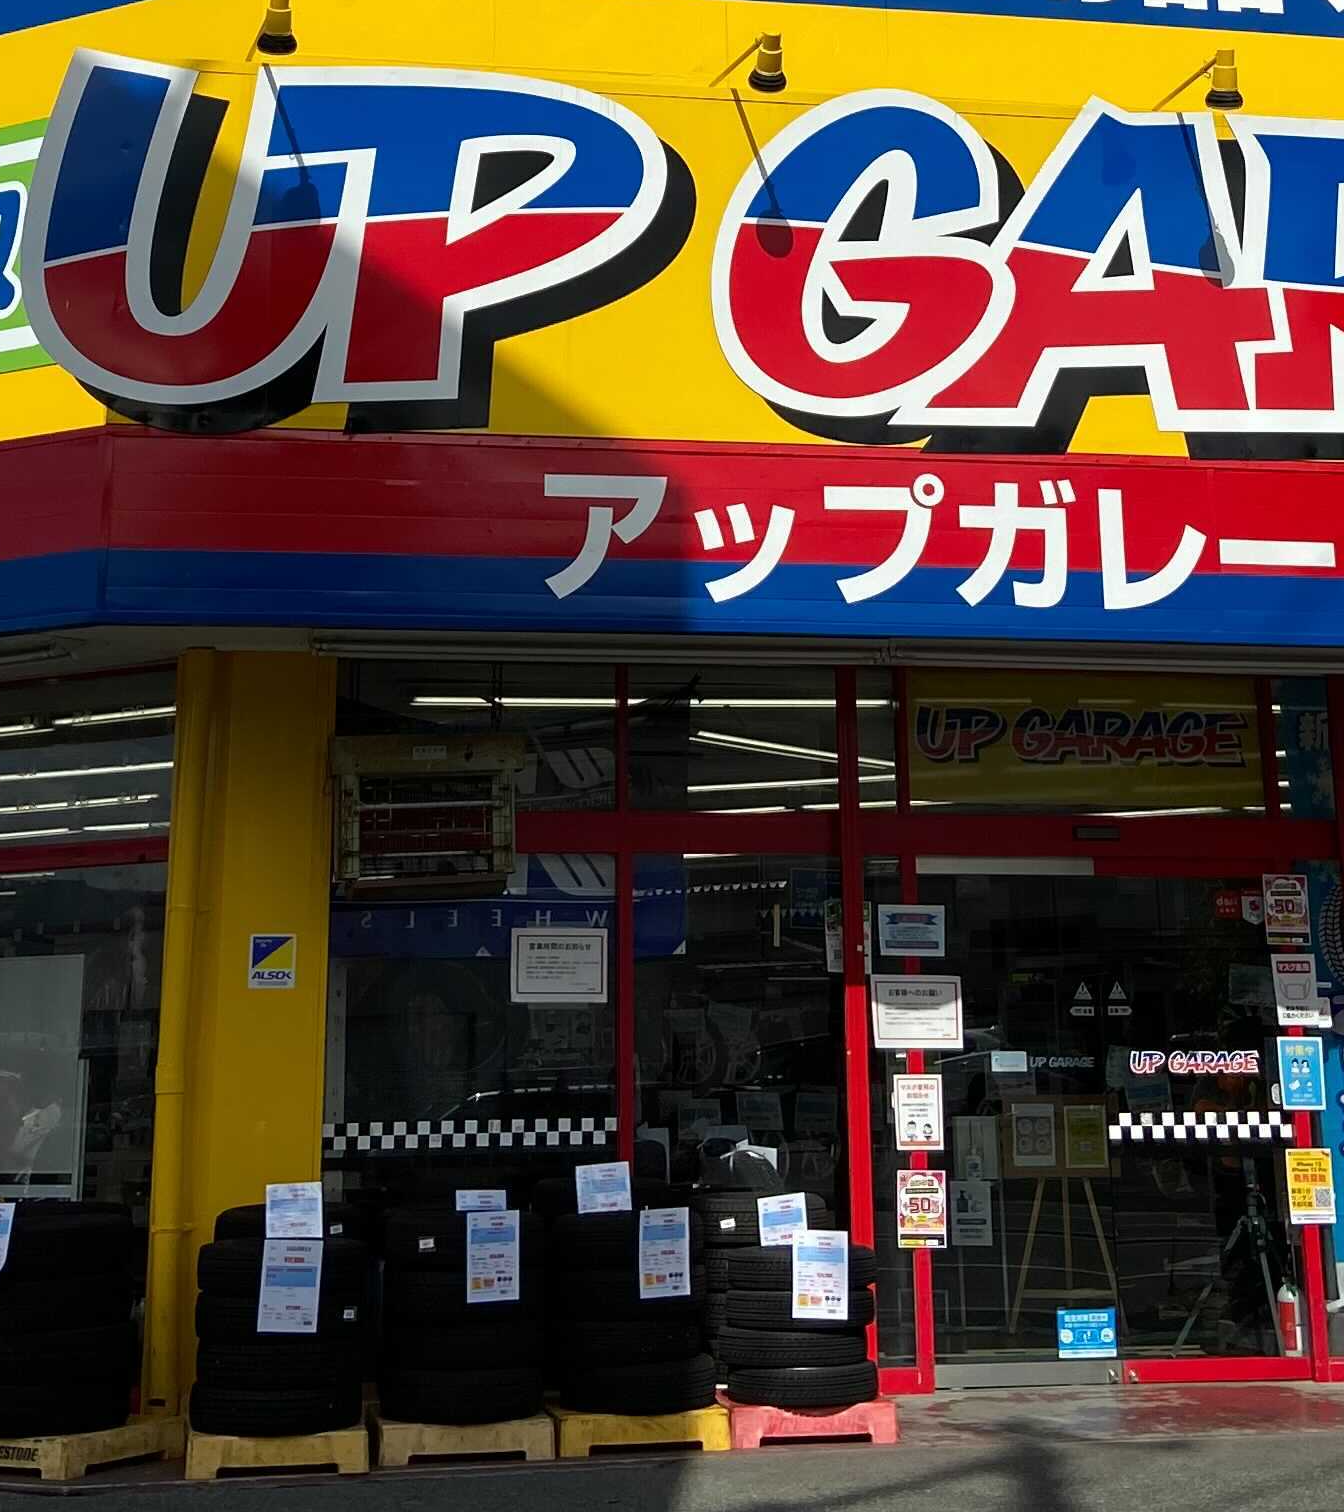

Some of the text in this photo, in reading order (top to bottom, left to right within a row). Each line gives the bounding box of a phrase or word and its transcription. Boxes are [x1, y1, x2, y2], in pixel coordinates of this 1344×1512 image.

[21, 48, 681, 418] UP
[916, 705, 1249, 767] UP GARAGE
[252, 970, 293, 980] ALSOK
[1049, 1056, 1095, 1068] GARAGE
[1130, 1050, 1260, 1074] UP GARAGE
